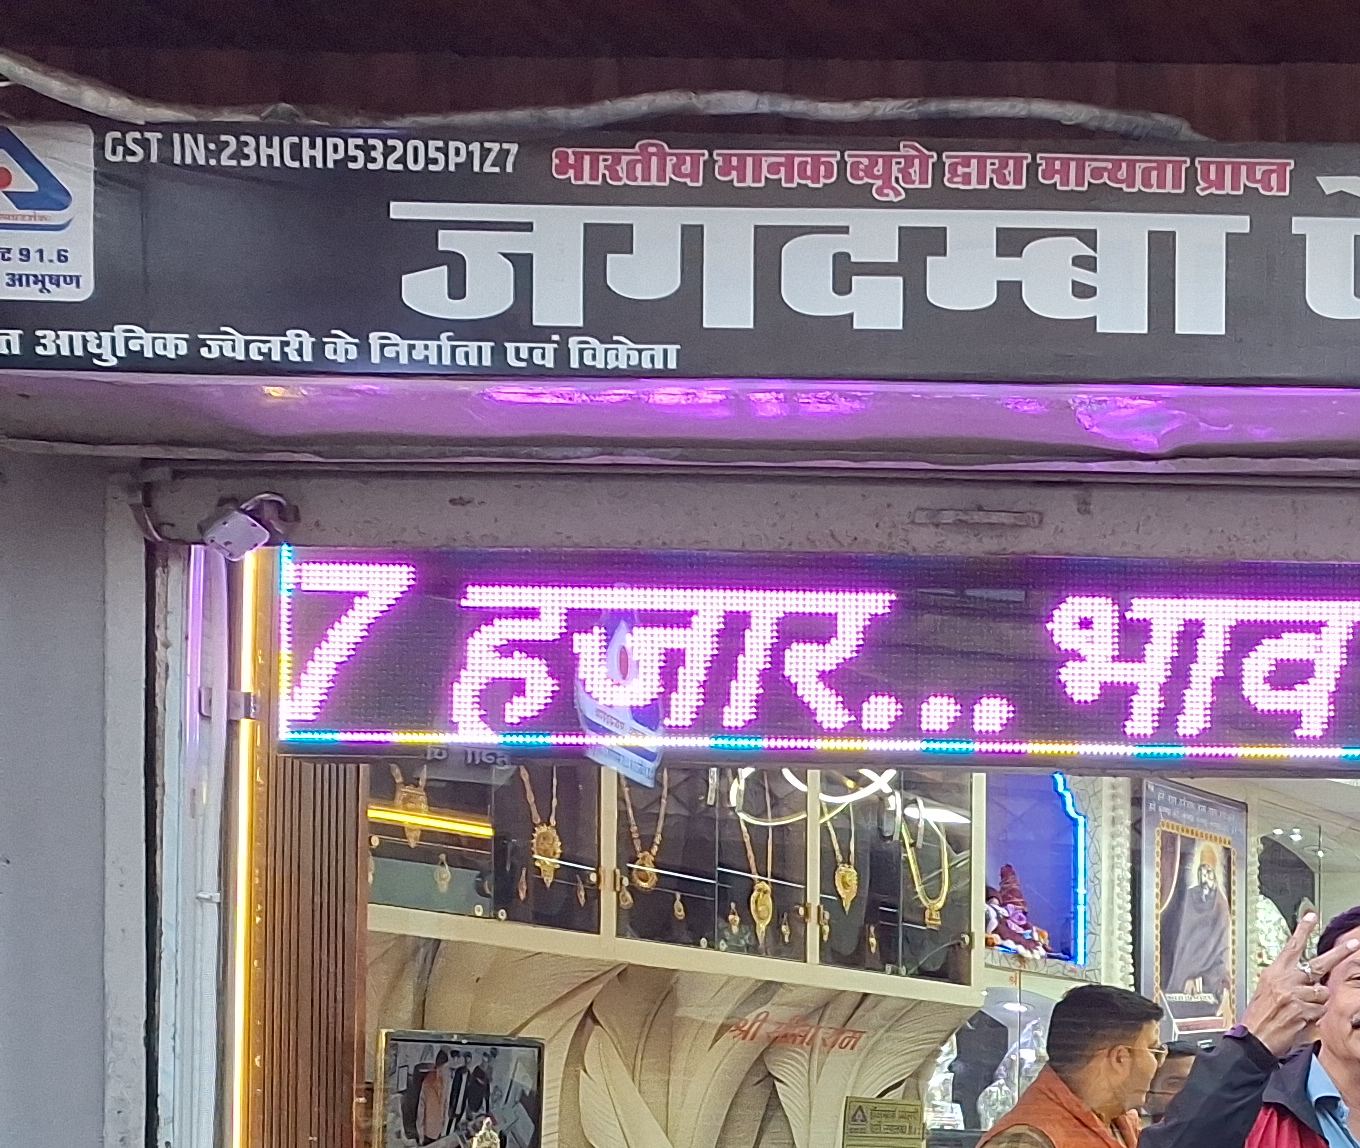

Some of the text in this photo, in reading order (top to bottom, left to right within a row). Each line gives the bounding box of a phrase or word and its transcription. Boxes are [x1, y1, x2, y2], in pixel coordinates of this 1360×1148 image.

[105, 132, 519, 173] GST IN:23HCHP53205P1Z7
[551, 139, 1295, 201] भारतीय मानक ब्यूरो द्वारा मान्यता प्राप्त
[17, 247, 70, 264] 91.6
[389, 201, 1250, 335] जगदम्बा
[5, 272, 83, 293] आभूषण
[35, 325, 189, 366] आधुनिक
[199, 326, 315, 363] ज्वेलरी
[323, 330, 359, 363] के
[368, 331, 495, 367] निर्माता
[504, 334, 562, 369] एवं
[568, 336, 680, 370] विक्रेता
